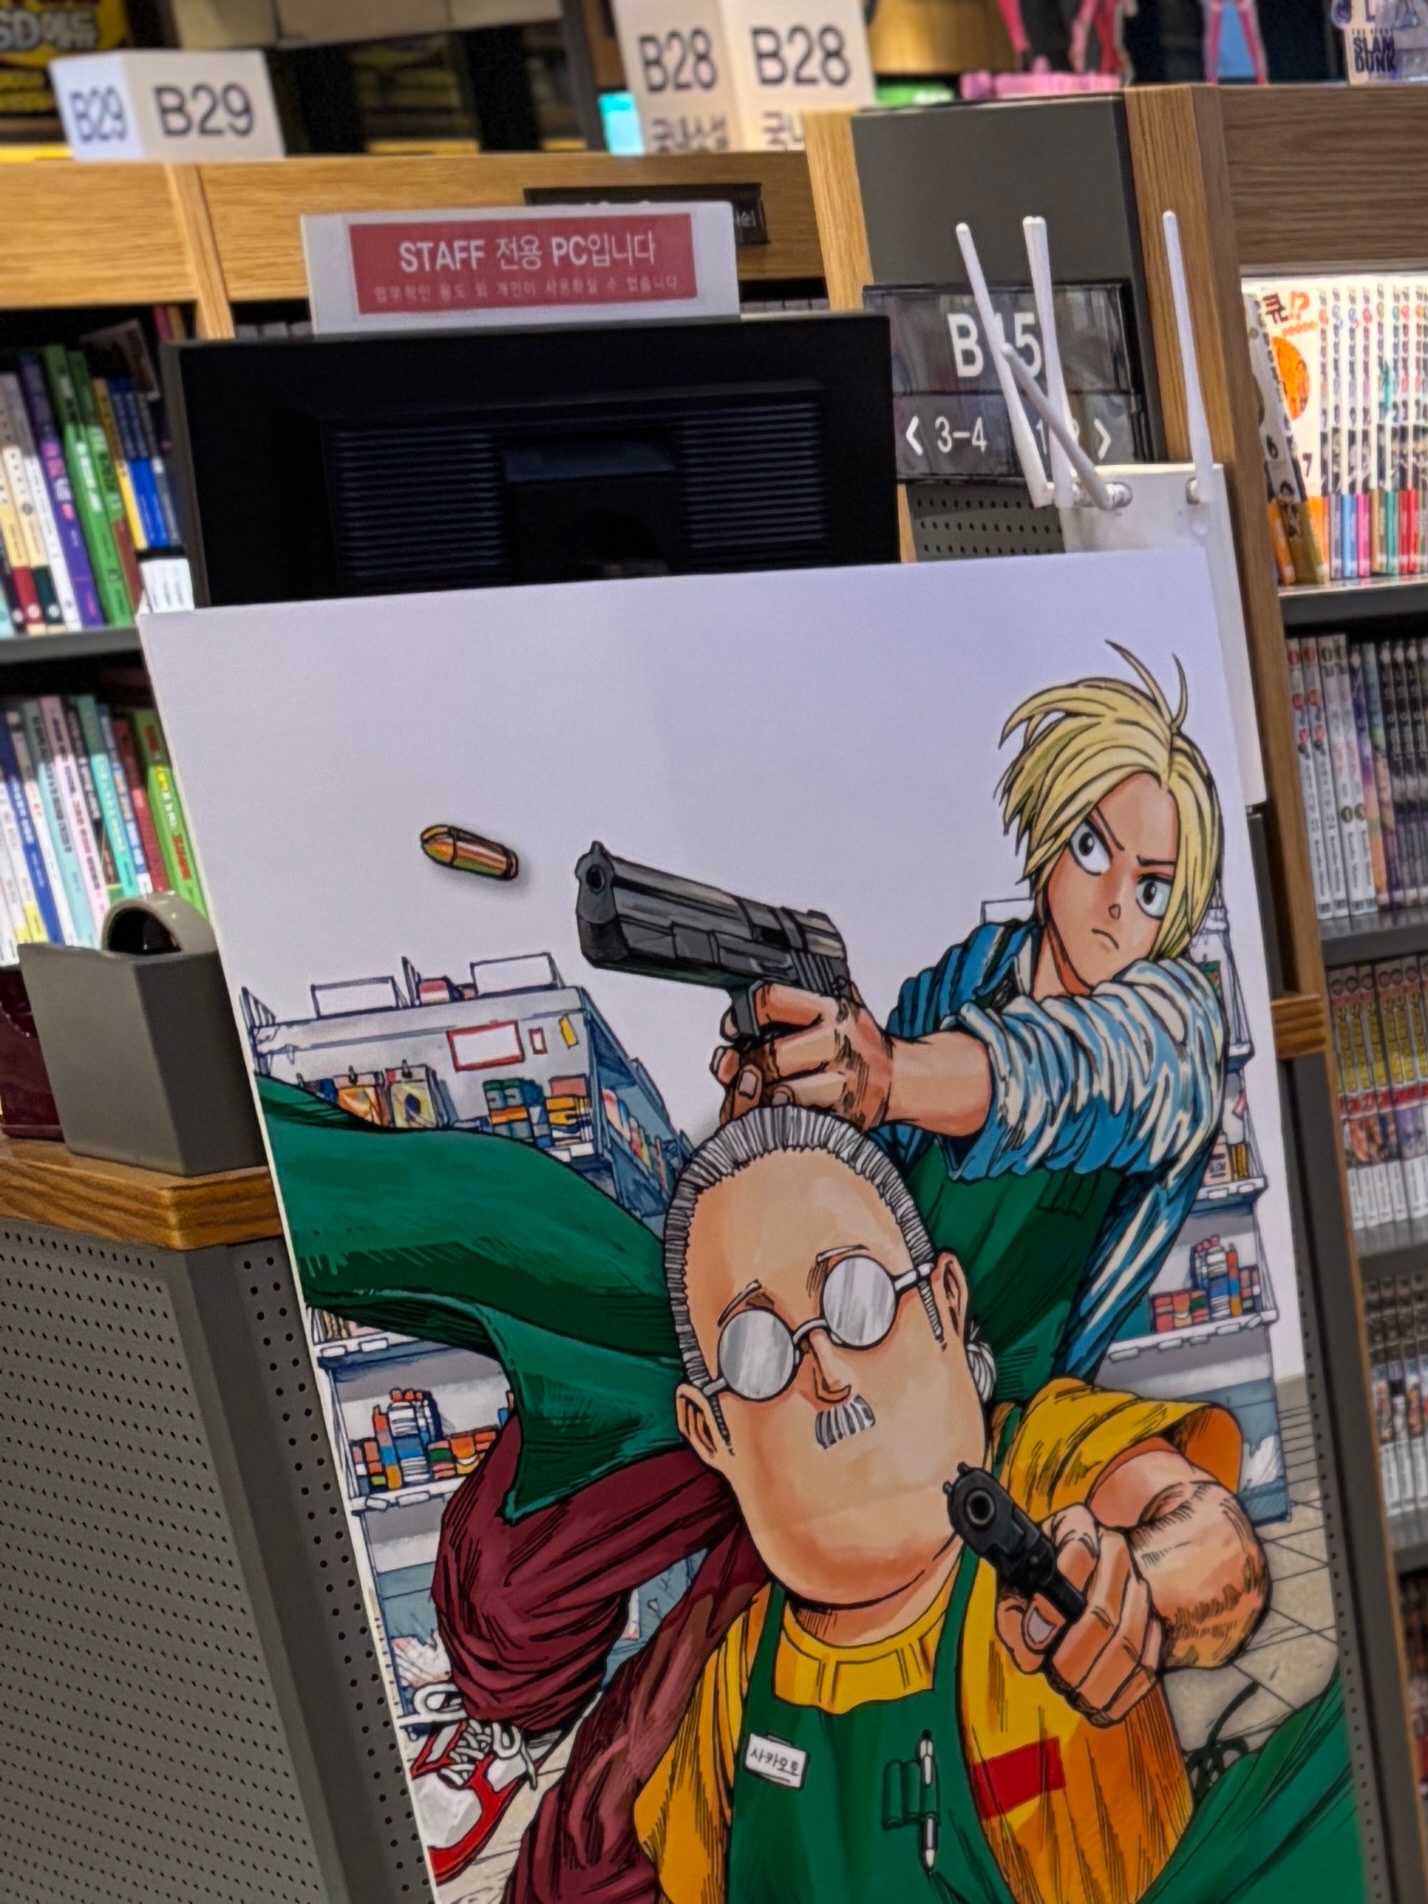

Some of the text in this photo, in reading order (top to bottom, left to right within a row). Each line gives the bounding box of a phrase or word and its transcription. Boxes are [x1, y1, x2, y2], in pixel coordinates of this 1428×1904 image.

[638, 27, 717, 93] B28
[751, 24, 850, 88] B28
[1352, 35, 1396, 53] SLAM
[1354, 52, 1398, 74] DUNK
[69, 85, 128, 143] B29
[153, 82, 255, 137] B29
[399, 230, 656, 273] STAFF 전용 PC입니다
[947, 313, 1042, 378] B5
[750, 1748, 799, 1777] 사카모토
